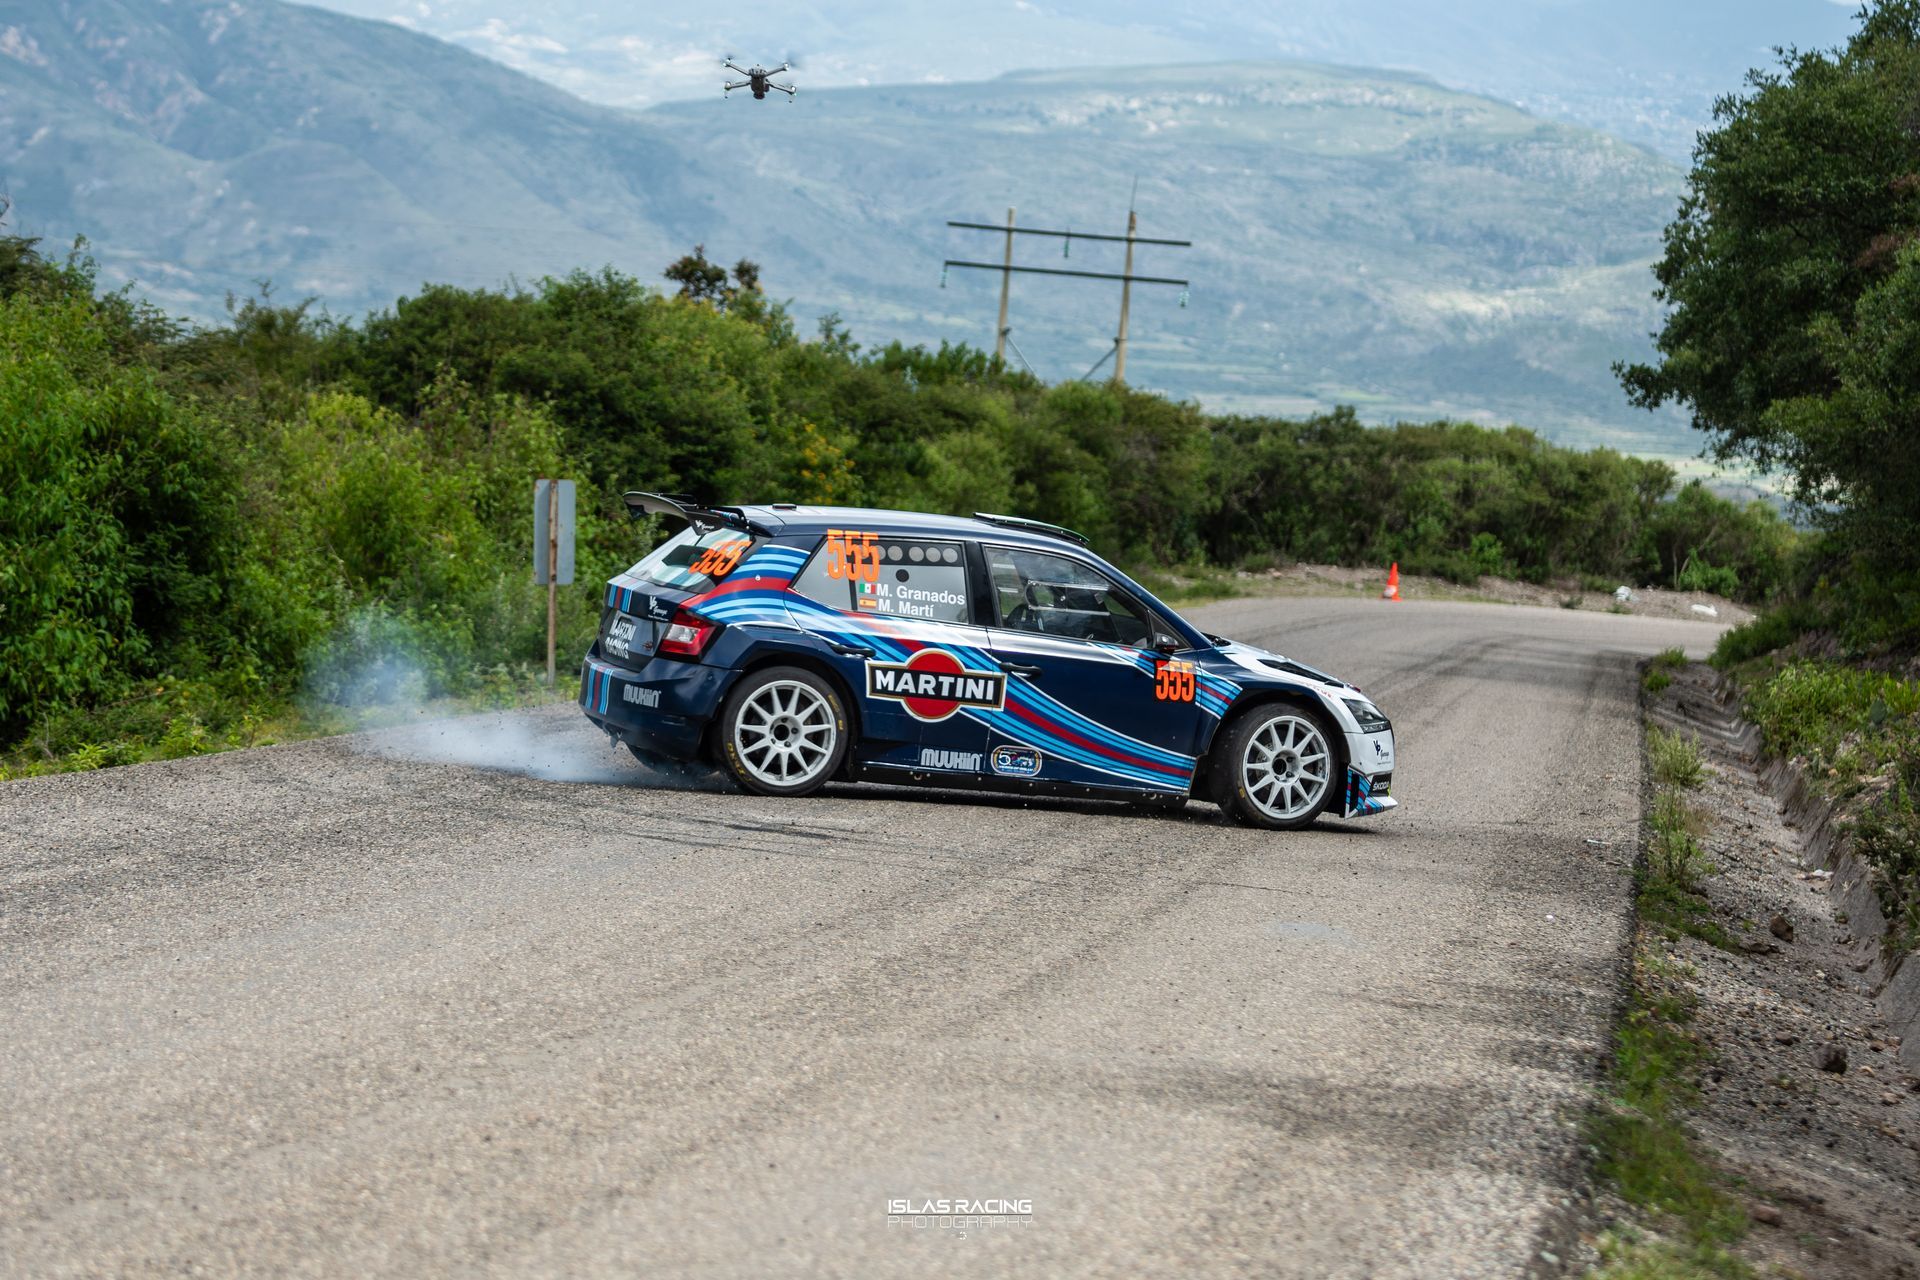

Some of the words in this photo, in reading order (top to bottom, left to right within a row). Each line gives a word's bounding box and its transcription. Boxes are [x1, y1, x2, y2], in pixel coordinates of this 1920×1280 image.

[688, 540, 753, 576] 555
[827, 528, 880, 582] 555
[876, 583, 893, 598] M.
[896, 586, 966, 605] Granados
[878, 598, 894, 613] M.
[898, 600, 934, 618] Martí
[875, 669, 995, 700] MARTINI
[1156, 660, 1195, 702] 555
